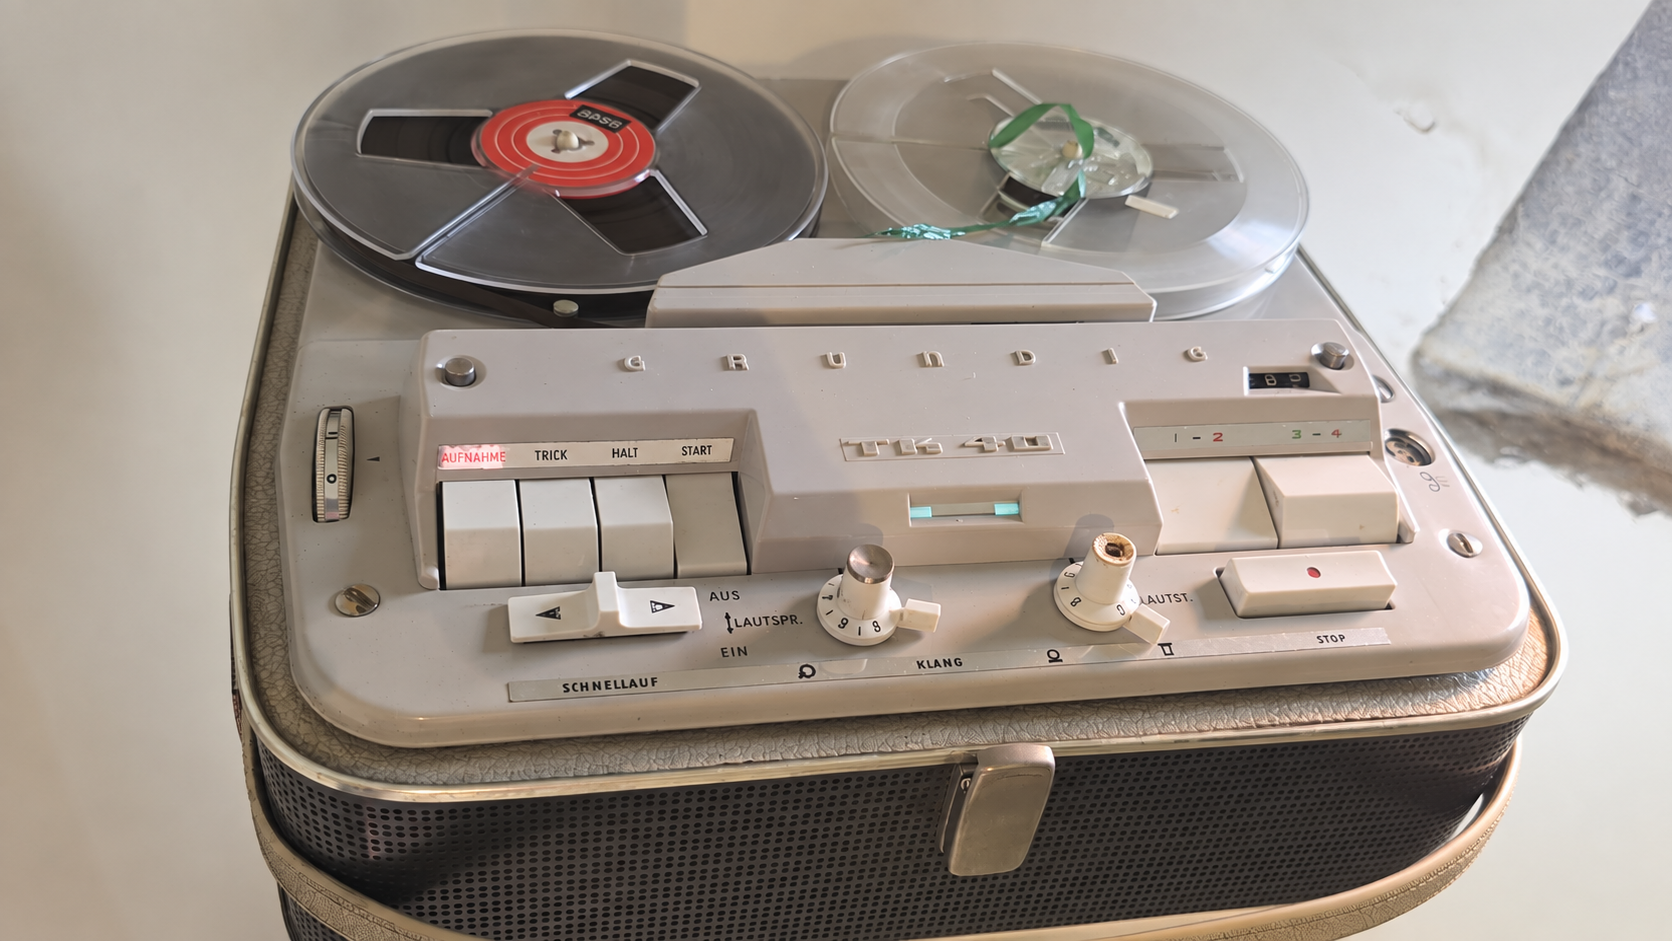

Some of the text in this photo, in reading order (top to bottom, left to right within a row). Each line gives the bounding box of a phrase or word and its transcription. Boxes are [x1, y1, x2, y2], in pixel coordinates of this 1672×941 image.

[441, 445, 713, 463] AUFNAHME TRICK HALT START
[709, 590, 741, 602] AUS
[734, 614, 803, 628] LAUTSPR.
[720, 646, 748, 658] EIN
[562, 634, 1346, 693] SCHNELLAUF KLANG STOP
